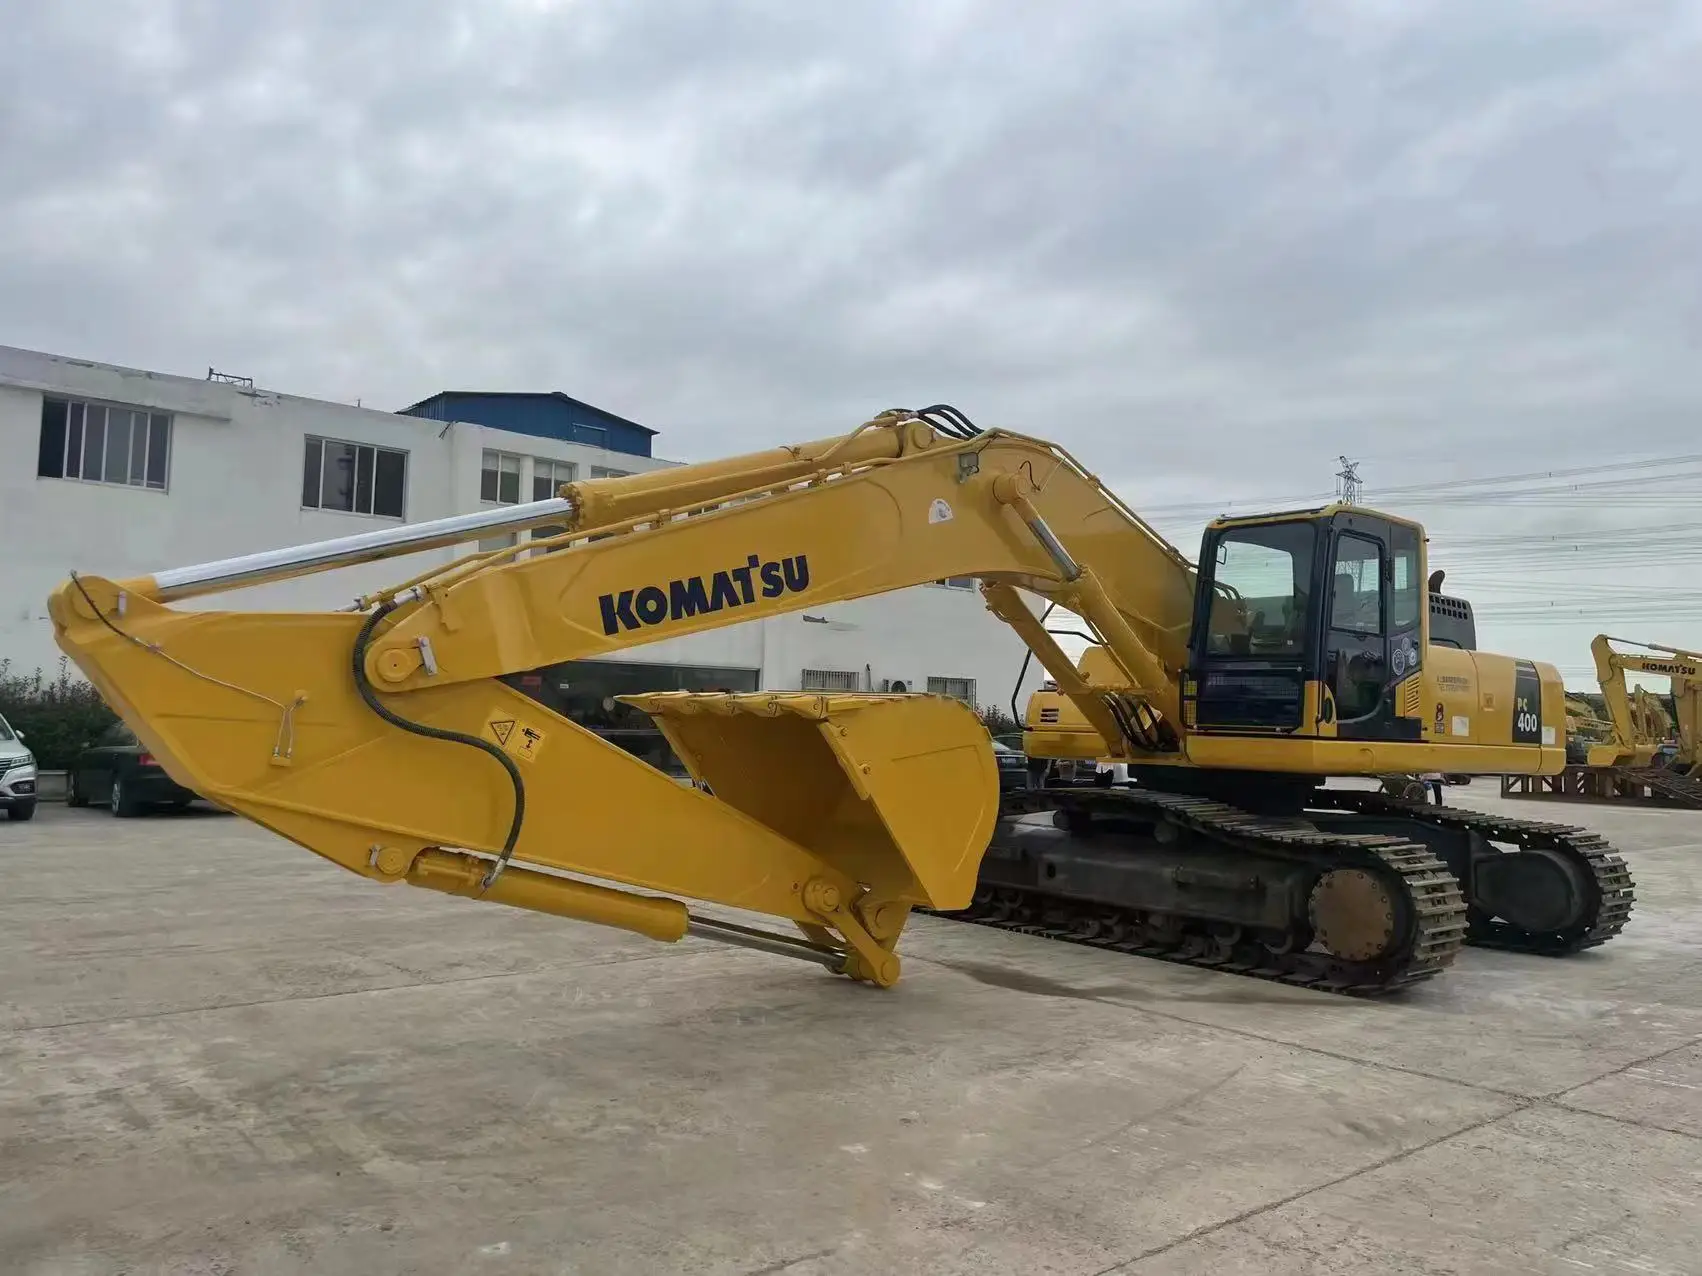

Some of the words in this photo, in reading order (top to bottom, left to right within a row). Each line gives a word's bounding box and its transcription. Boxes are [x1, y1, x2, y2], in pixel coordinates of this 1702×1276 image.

[598, 554, 810, 636] KOMATSU
[1641, 662, 1696, 675] KOMATSU
[1517, 697, 1528, 711] PC
[1517, 712, 1538, 732] 400
